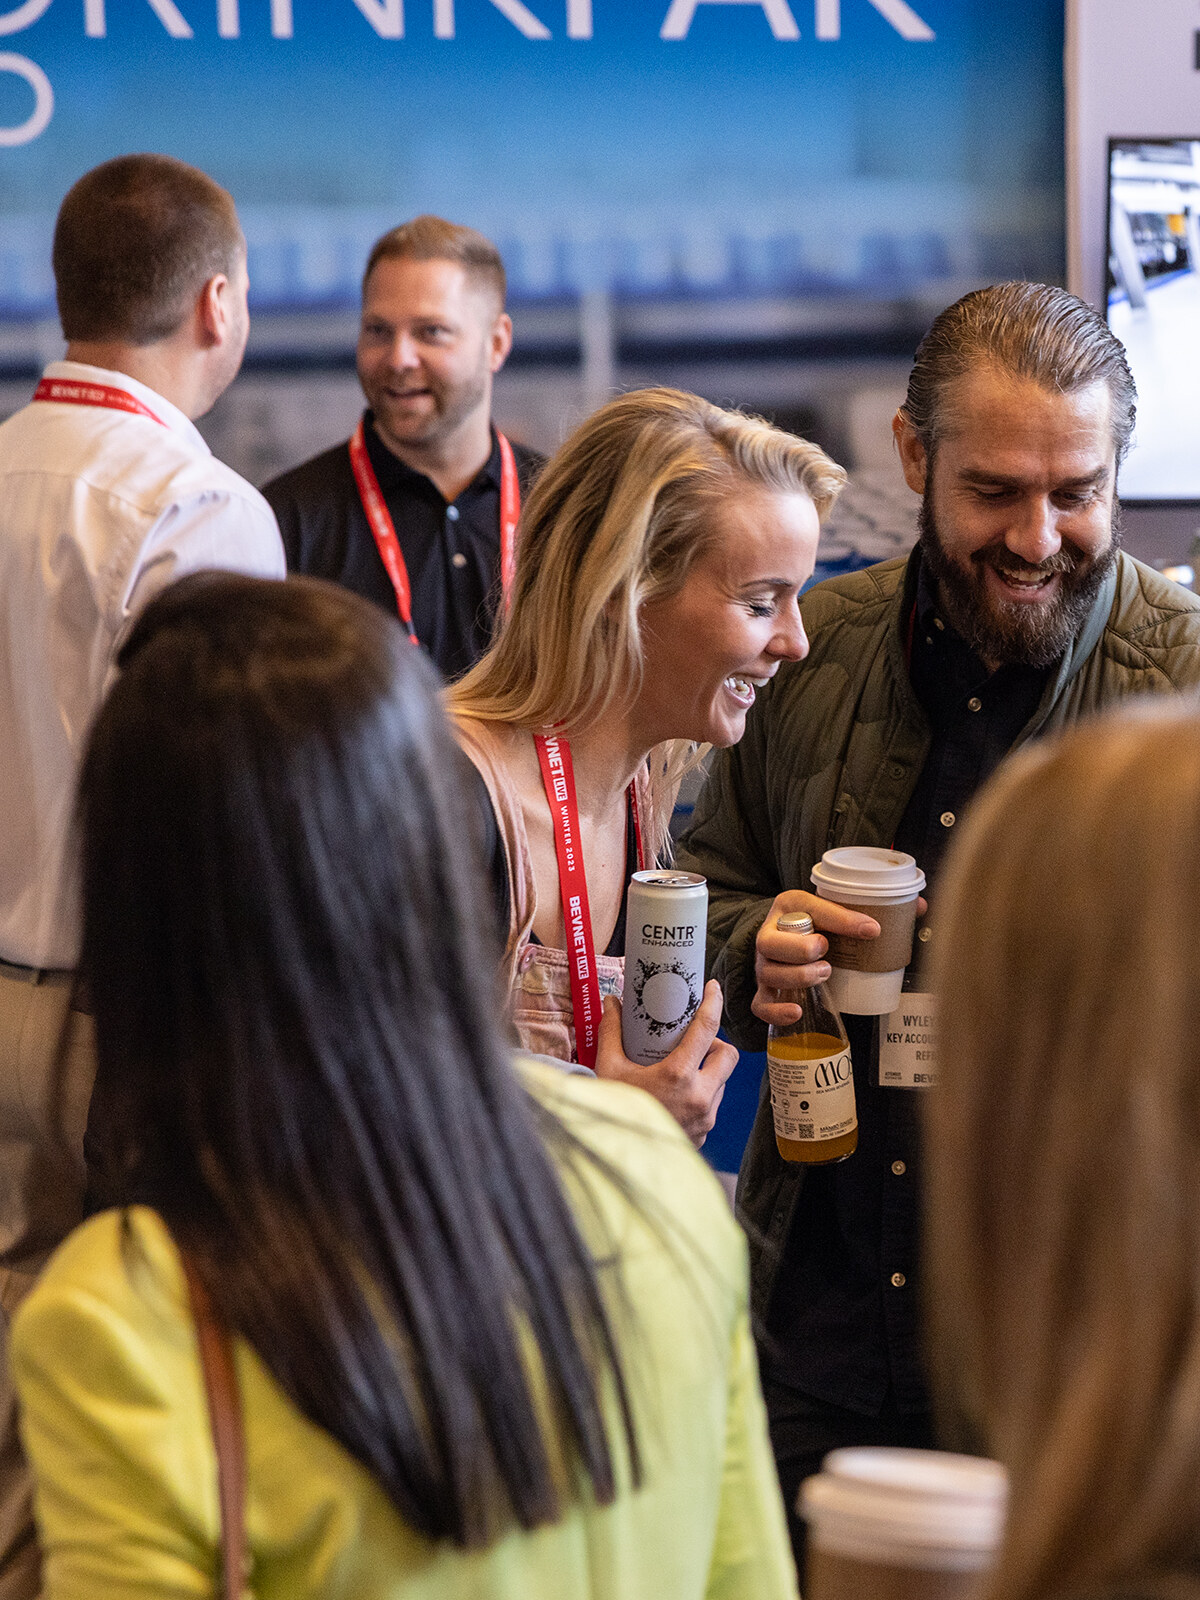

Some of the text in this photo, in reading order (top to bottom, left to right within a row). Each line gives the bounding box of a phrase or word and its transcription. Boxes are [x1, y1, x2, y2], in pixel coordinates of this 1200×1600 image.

[553, 777, 568, 802] LIVE
[560, 805, 573, 845] WINTER
[565, 847, 576, 872] 2023
[642, 924, 695, 940] CENTR
[642, 938, 695, 947] ENHANCED
[569, 895, 594, 1048] BEVNET LIVE WINTER 2023
[886, 1033, 903, 1043] KEY
[814, 1055, 853, 1088] MO
